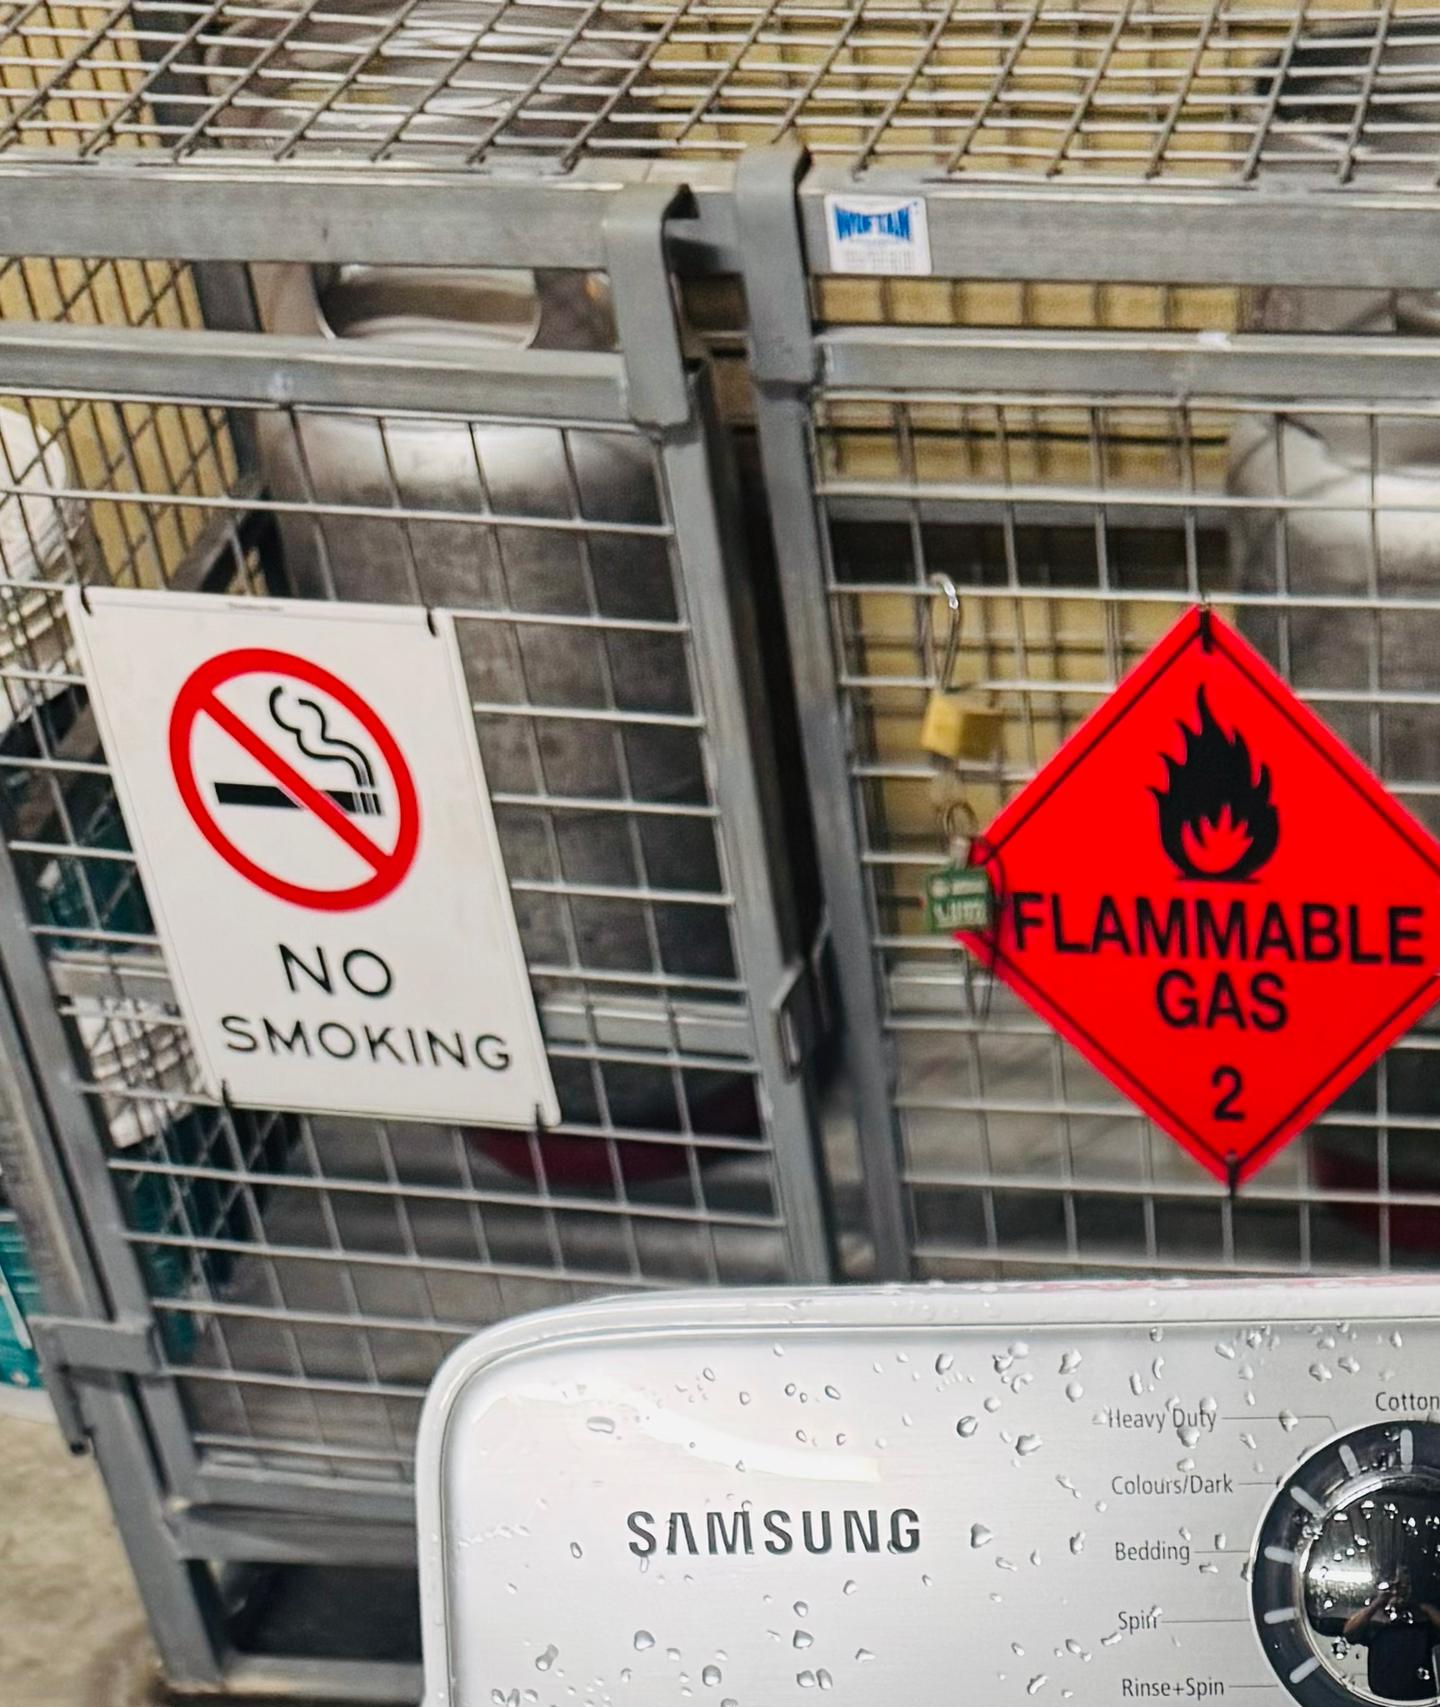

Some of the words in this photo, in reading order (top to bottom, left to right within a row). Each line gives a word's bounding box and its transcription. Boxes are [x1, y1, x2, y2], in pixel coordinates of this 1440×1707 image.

[1010, 892, 1424, 966] FLAMMABLE
[278, 943, 392, 997] NO
[1156, 970, 1288, 1031] GAS
[220, 1015, 513, 1071] SMOKING
[1210, 1066, 1245, 1122] 2
[1107, 1408, 1166, 1433] Heavy
[1172, 1408, 1217, 1432] Duty
[1375, 1391, 1440, 1412] Cotton
[1111, 1474, 1234, 1496] Colours/Dark
[626, 1507, 921, 1556] SAMSUNG
[1114, 1541, 1191, 1565] Bedding
[1118, 1609, 1158, 1636] Spin
[1121, 1677, 1225, 1700] Rinse+Spin
